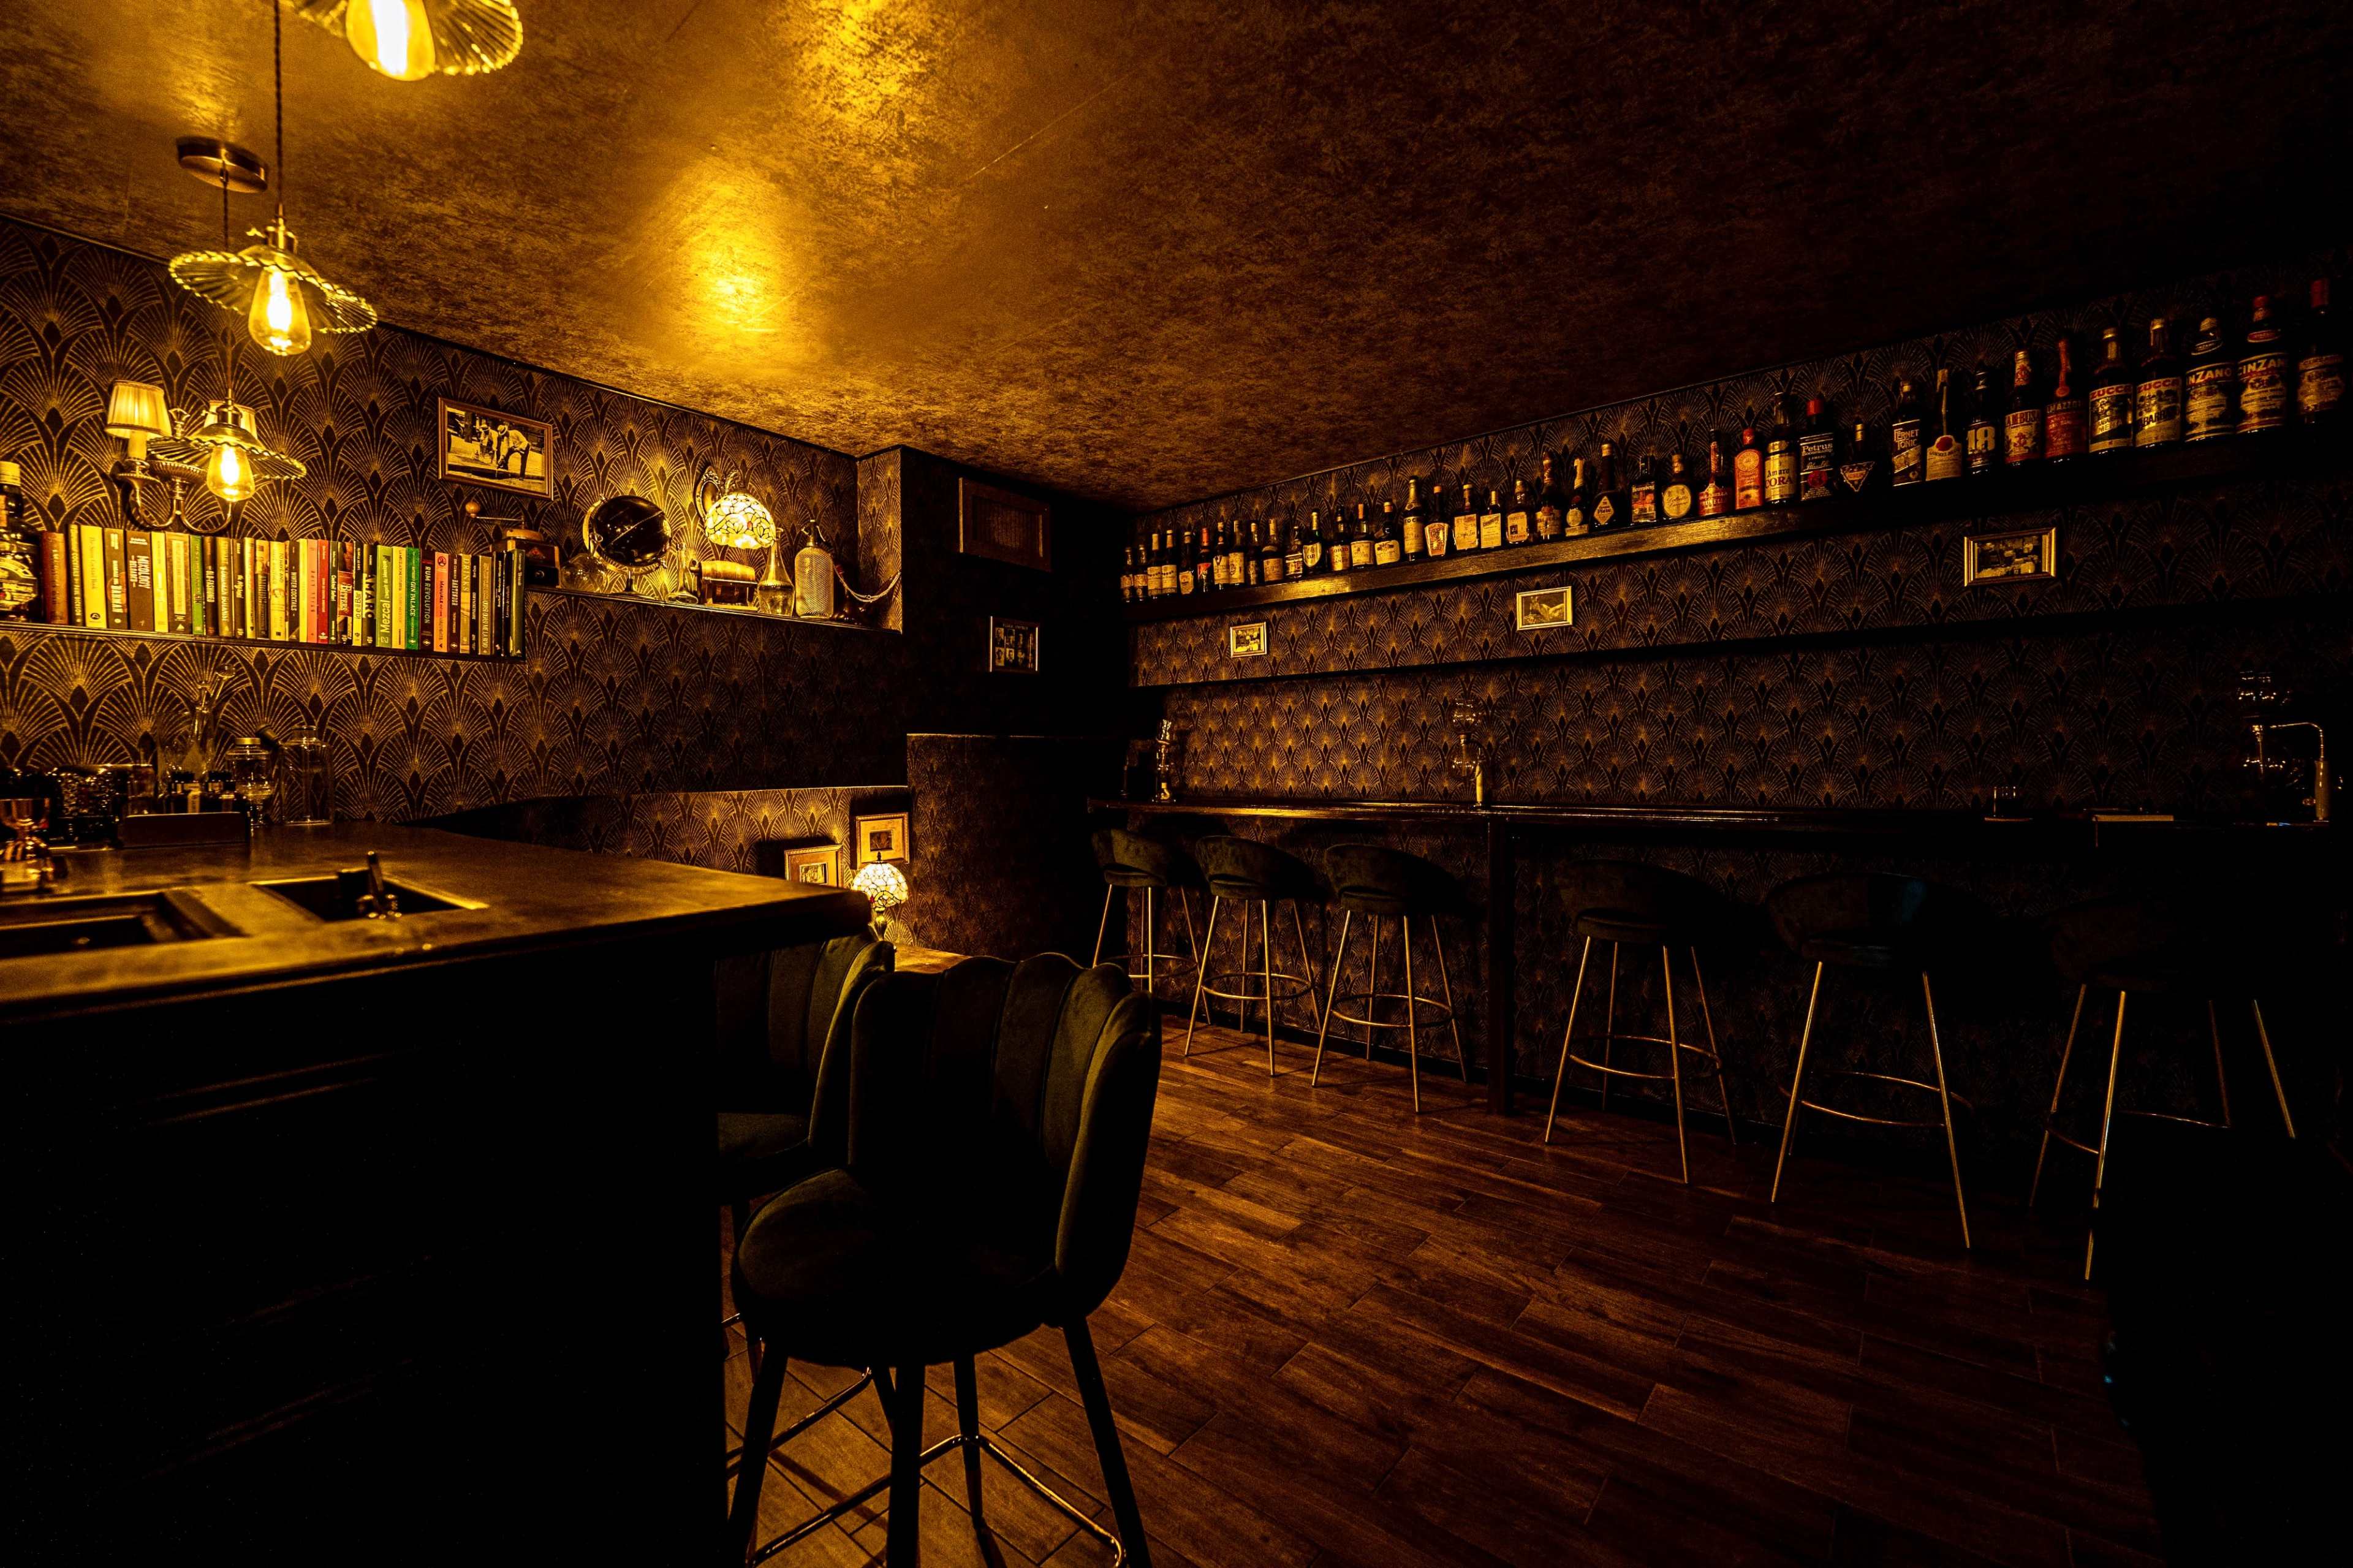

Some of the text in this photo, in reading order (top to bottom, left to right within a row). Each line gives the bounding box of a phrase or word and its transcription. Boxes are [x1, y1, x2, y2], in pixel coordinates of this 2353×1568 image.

[2237, 358, 2285, 376] CINZAN
[1893, 428, 1920, 442] FERNET
[1896, 439, 1918, 450] TONIC
[1802, 443, 1833, 453] Petrus
[1765, 476, 1794, 489] CORA
[1767, 468, 1789, 477] Amaro
[72, 552, 80, 577] COCKTAILS
[137, 555, 151, 589] MIXOLOGY
[206, 570, 215, 603] OLD-FASHIONED
[365, 574, 376, 618] AMARO
[339, 584, 352, 612] BITTERS
[380, 600, 391, 633] Mezcal
